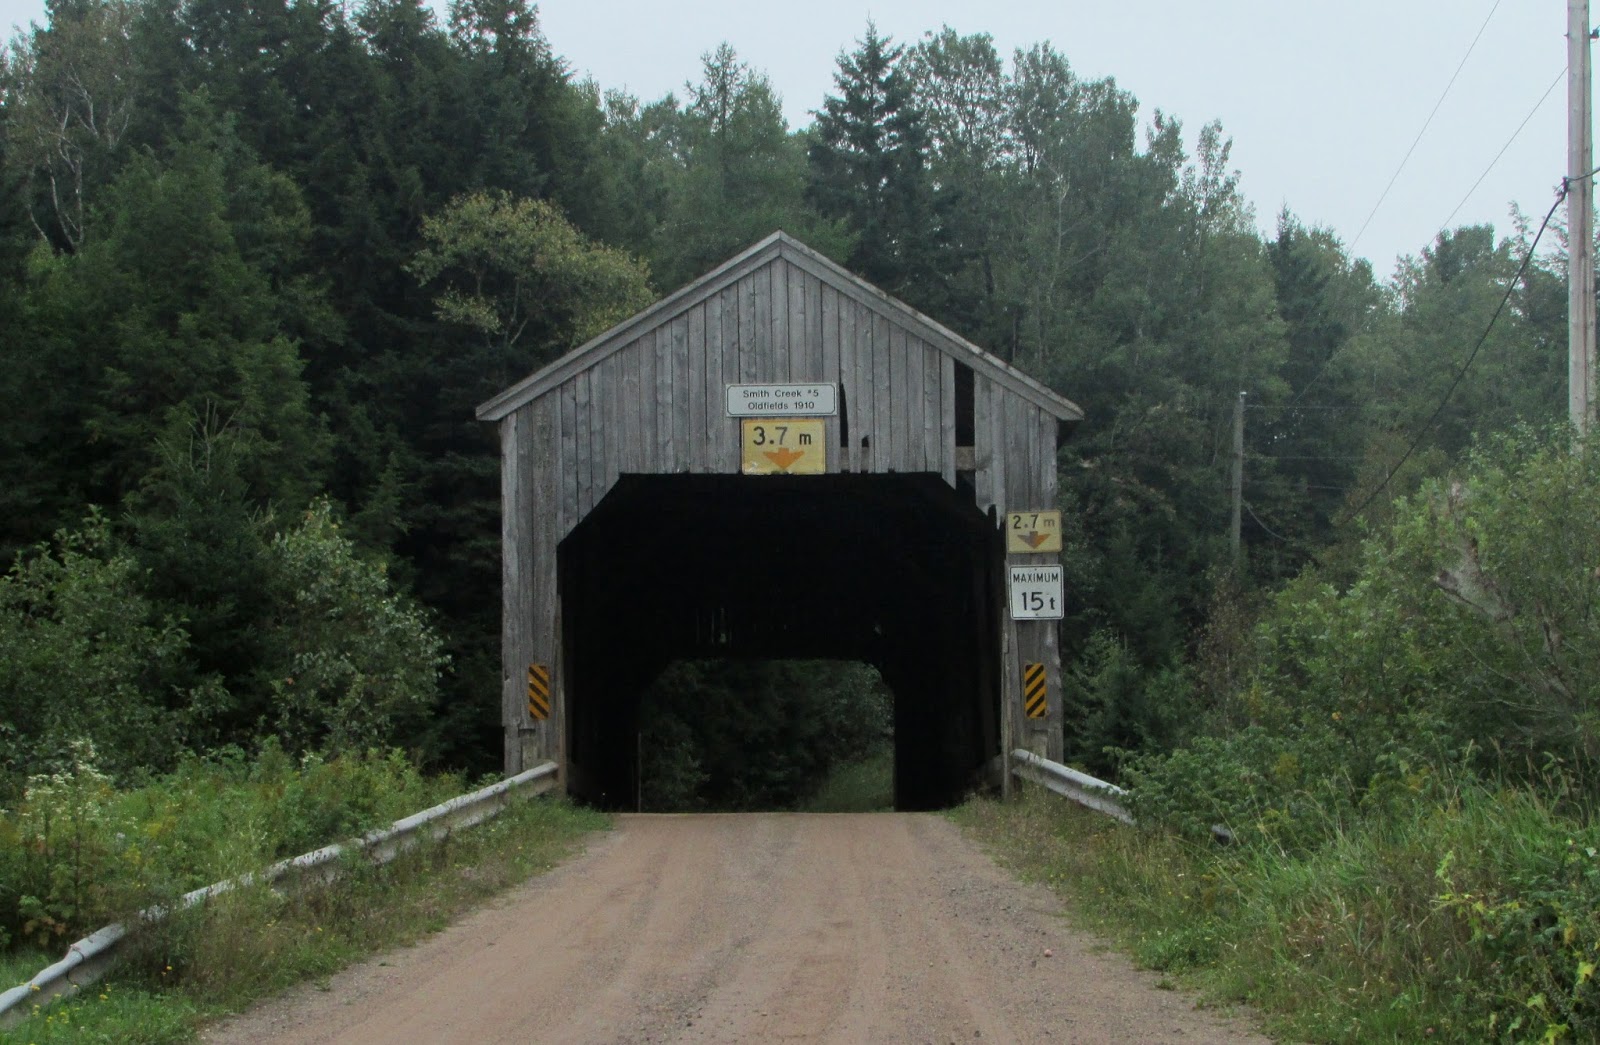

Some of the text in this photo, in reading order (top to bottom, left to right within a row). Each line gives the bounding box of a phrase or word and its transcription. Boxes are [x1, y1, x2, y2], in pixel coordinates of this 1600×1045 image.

[743, 389, 770, 398] Smith
[774, 389, 802, 398] Creek
[748, 401, 815, 410] Oldfields 1910
[753, 426, 812, 446] 3.7 m
[1012, 514, 1055, 529] 2.7 m
[1013, 572, 1059, 583] MAXIMUM
[1021, 591, 1056, 611] 15 t
